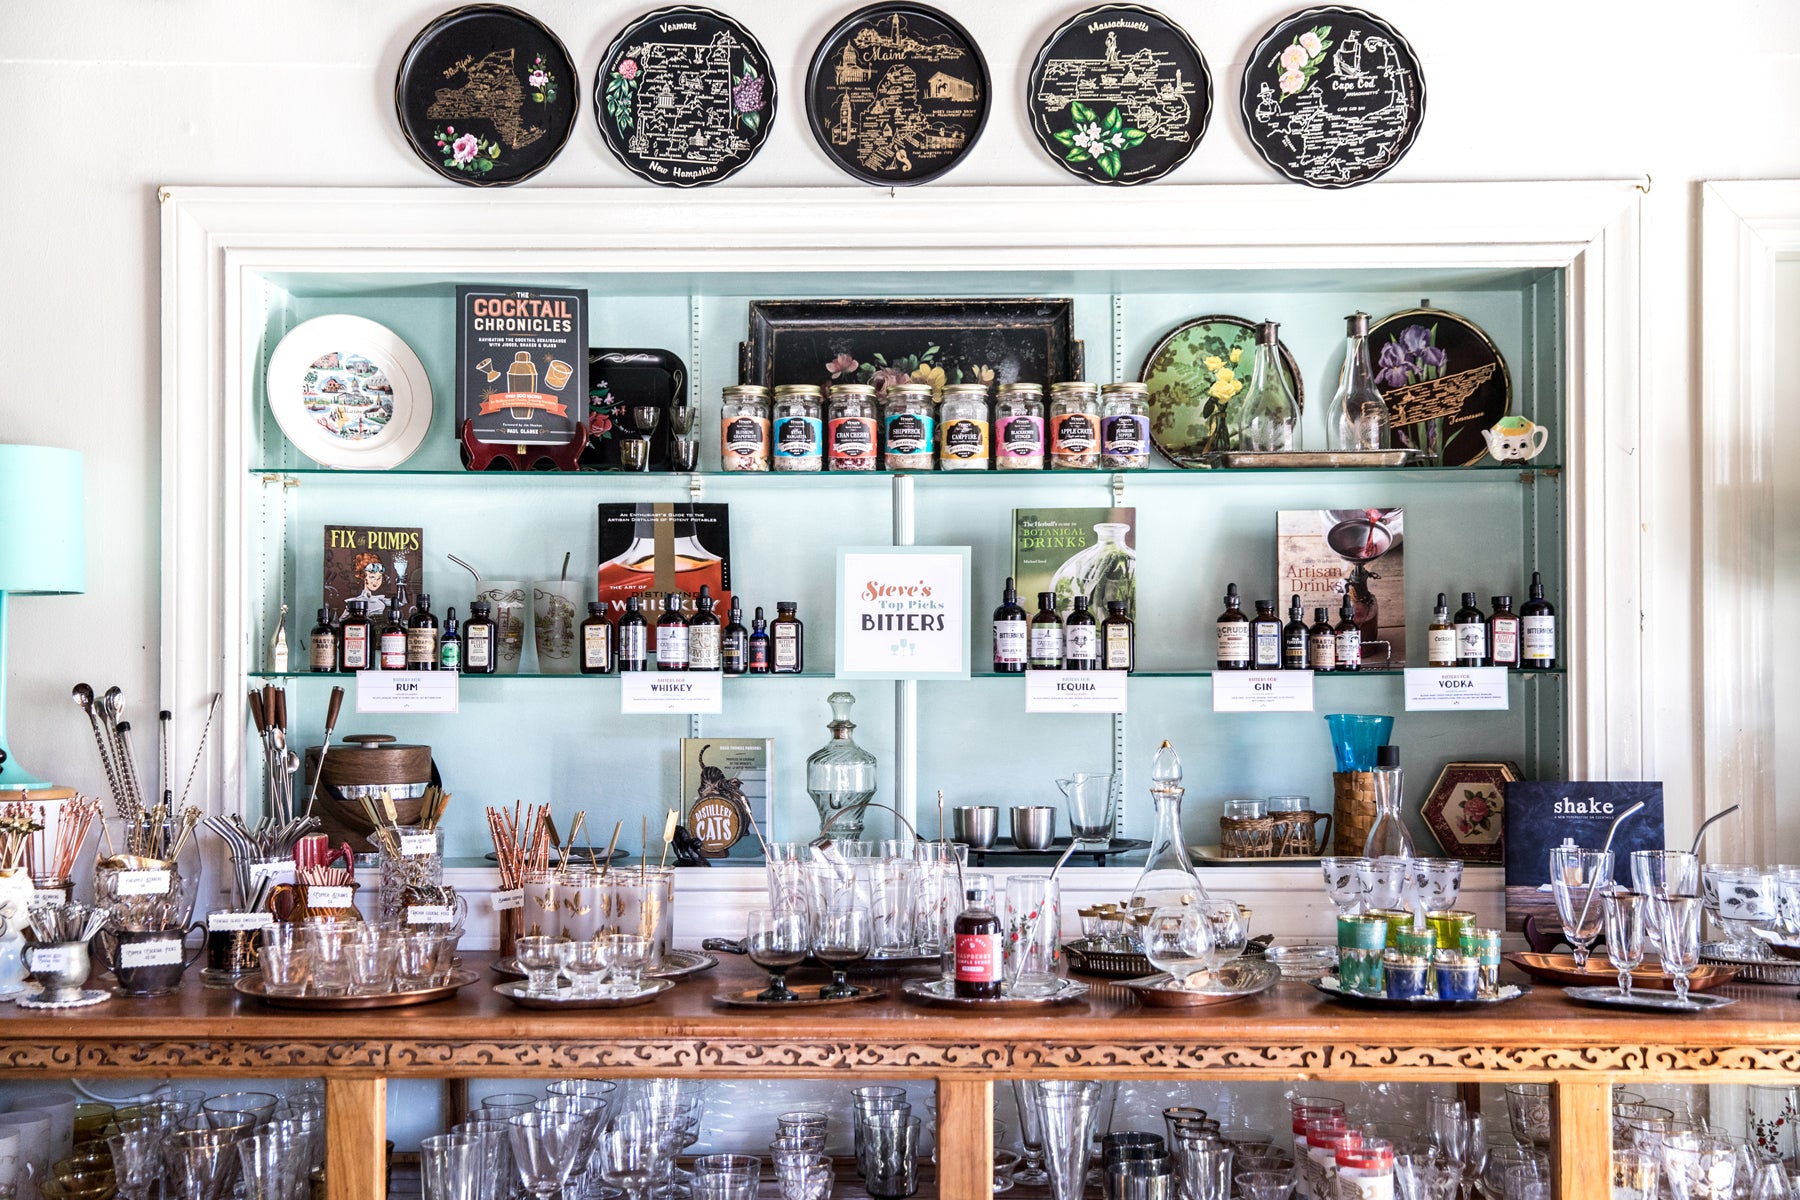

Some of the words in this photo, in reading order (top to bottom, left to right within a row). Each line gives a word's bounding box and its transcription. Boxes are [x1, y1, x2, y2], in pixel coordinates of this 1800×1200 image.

[660, 21, 697, 33] Vermont
[1088, 18, 1149, 34] Massachusetts
[863, 47, 907, 62] Maine
[455, 54, 475, 72] York
[1332, 80, 1355, 92] Cape
[1357, 79, 1376, 88] Cod
[649, 160, 668, 174] New
[673, 166, 718, 179] Hampshire
[474, 298, 572, 318] COCKTAIL
[474, 318, 572, 332] CHRONICLES
[1024, 528, 1086, 536] BOTANICAL
[330, 530, 357, 548] FIX
[368, 531, 420, 551] PUMPS
[1024, 537, 1086, 549] DRINKS
[1286, 565, 1342, 578] Artisan
[861, 580, 932, 601] Steve's
[1291, 578, 1343, 593] Drinks
[878, 600, 903, 611] Top
[908, 600, 944, 609] Picks
[862, 614, 944, 631] BITTERS
[1057, 683, 1096, 691] TEQUILA
[1438, 680, 1474, 688] VODKA
[695, 803, 733, 822] DISTILLERY
[1554, 797, 1614, 814] shake
[695, 817, 732, 841] CATS
